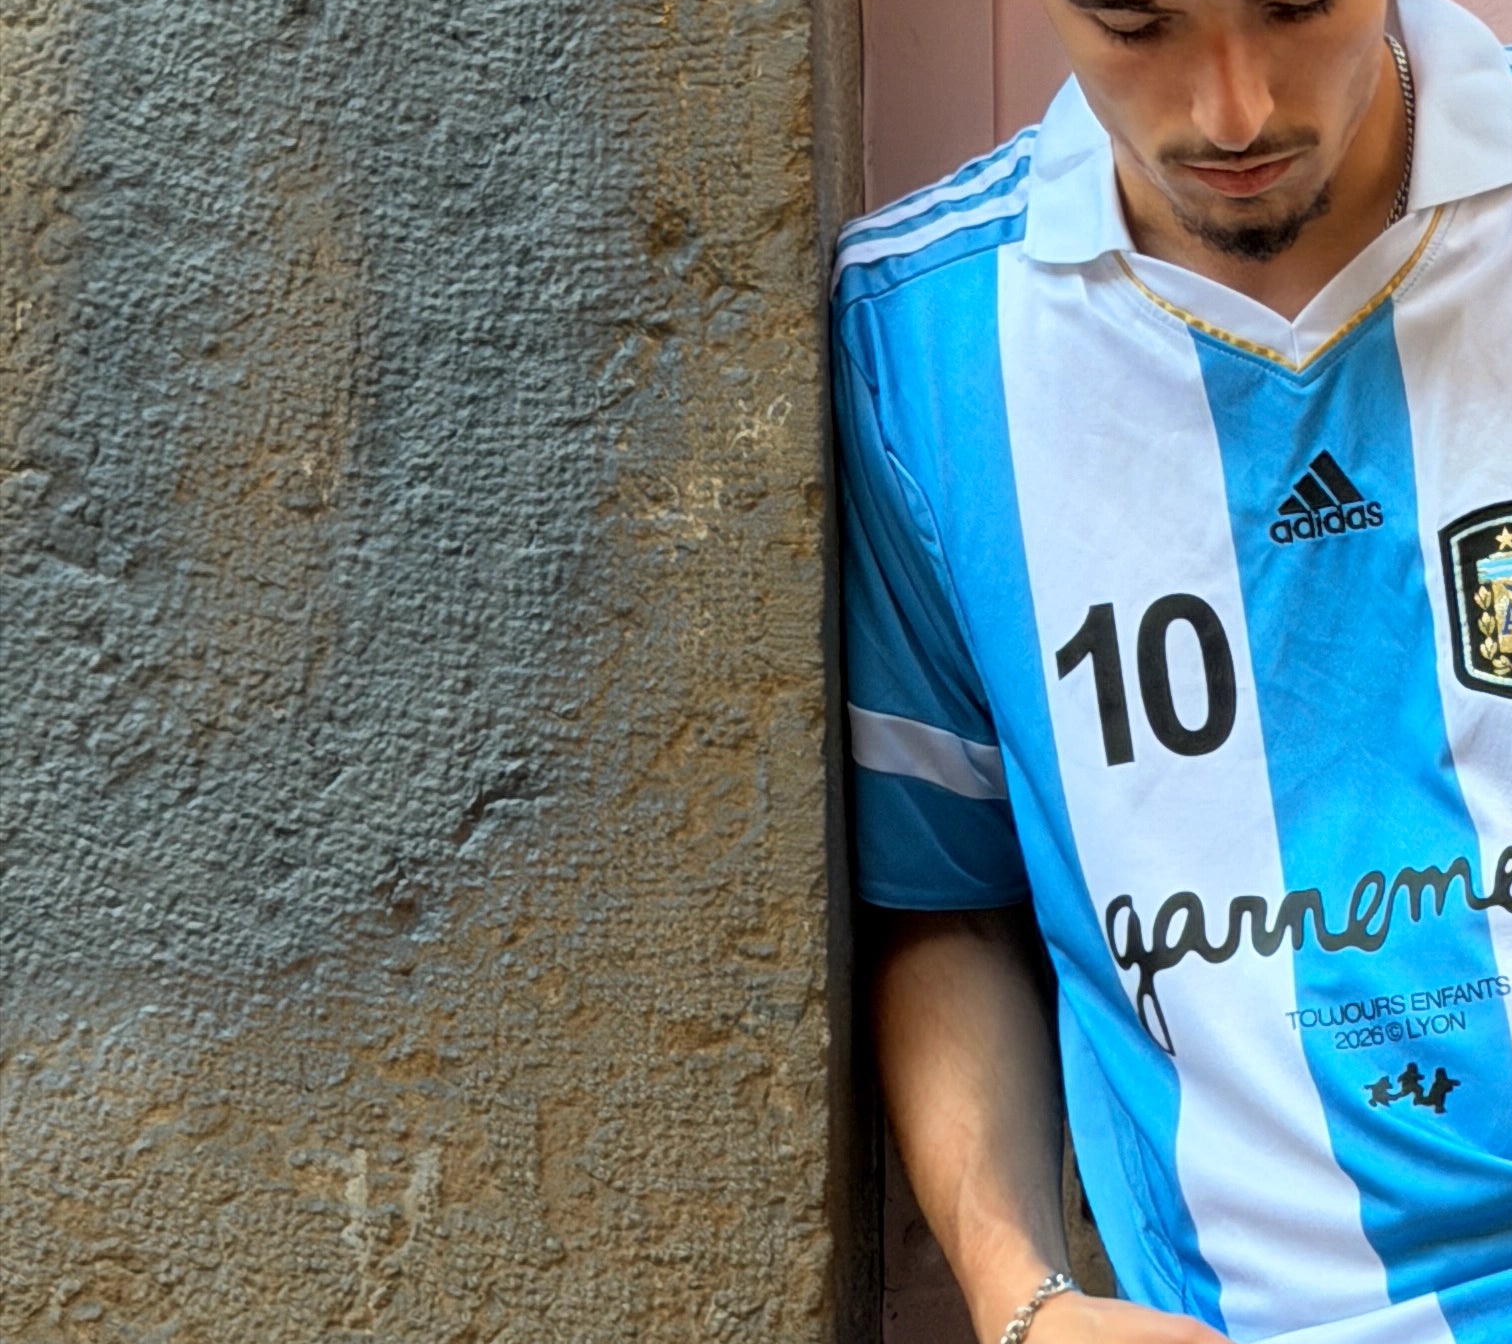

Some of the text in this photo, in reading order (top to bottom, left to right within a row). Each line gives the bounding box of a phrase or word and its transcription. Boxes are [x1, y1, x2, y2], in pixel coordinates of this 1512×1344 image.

[1269, 500, 1384, 544] adidas
[1055, 593, 1238, 767] 10
[1285, 976, 1512, 1030] TOUJOURS ENFANTS
[1334, 1025, 1385, 1050] 2026
[1405, 1011, 1466, 1040] LYON
